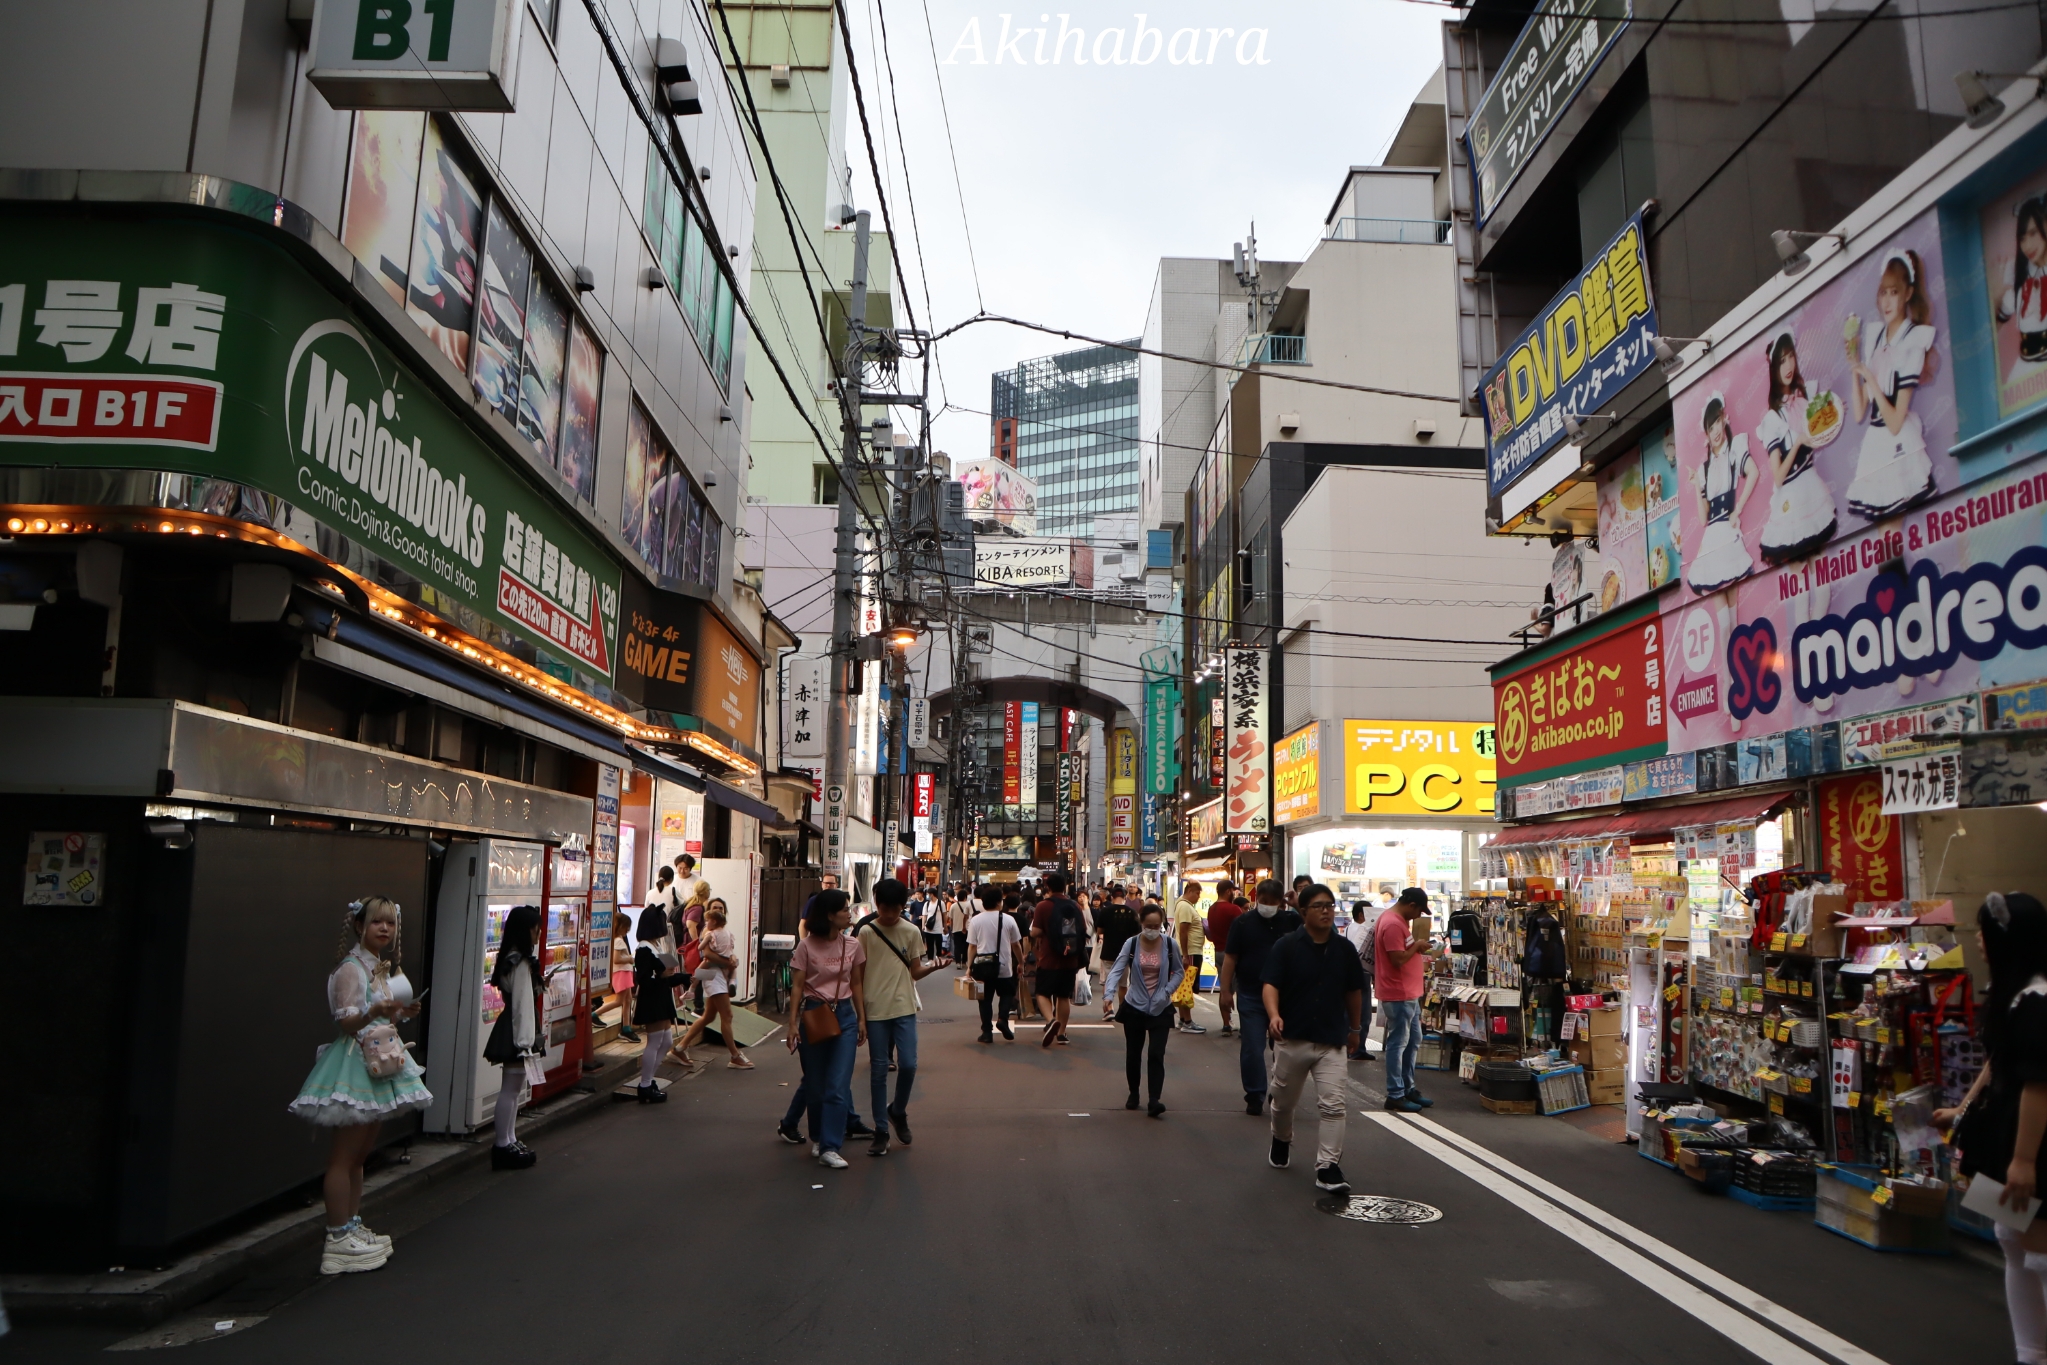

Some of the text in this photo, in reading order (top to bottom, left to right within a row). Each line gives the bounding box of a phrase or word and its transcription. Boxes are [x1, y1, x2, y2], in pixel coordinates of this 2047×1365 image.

[352, 0, 456, 61] B1
[1501, 46, 1539, 114] Free
[1506, 15, 1599, 168] ランドリー完備
[1508, 225, 1650, 428] DVD鑑賞
[94, 390, 188, 428] B1F
[301, 351, 487, 569] Melonbooks
[430, 551, 453, 583] total
[455, 566, 479, 599] shop.
[502, 510, 591, 621] 店舗受取館
[976, 544, 1065, 562] エンターテインメント
[977, 565, 1064, 581] KIBA RESORTS
[1779, 568, 1811, 601] No.1
[1815, 545, 1858, 587] Maid
[1860, 530, 1905, 567] Cafe
[1908, 523, 1923, 550] &
[500, 578, 550, 632] この先120m
[570, 622, 598, 661] 鈴木ビル
[601, 582, 617, 641] 120 m
[645, 620, 660, 638] 3F
[662, 625, 680, 642] 4F
[624, 632, 691, 684] GAME
[1687, 622, 1710, 660] 2F
[1644, 624, 1662, 727] 2号店
[1677, 684, 1715, 713] ENTRANCE
[1006, 721, 1014, 743] CAFE
[1156, 686, 1167, 791] TSUKUMO
[1357, 728, 1460, 753] デジタル
[1531, 706, 1624, 754] akibaoo.co.jp
[1071, 756, 1080, 782] DVD
[1884, 753, 1962, 806] スマホ充電
[919, 788, 929, 815] KFC
[827, 805, 840, 861] 福山歯科
[590, 966, 607, 981] Welcome
